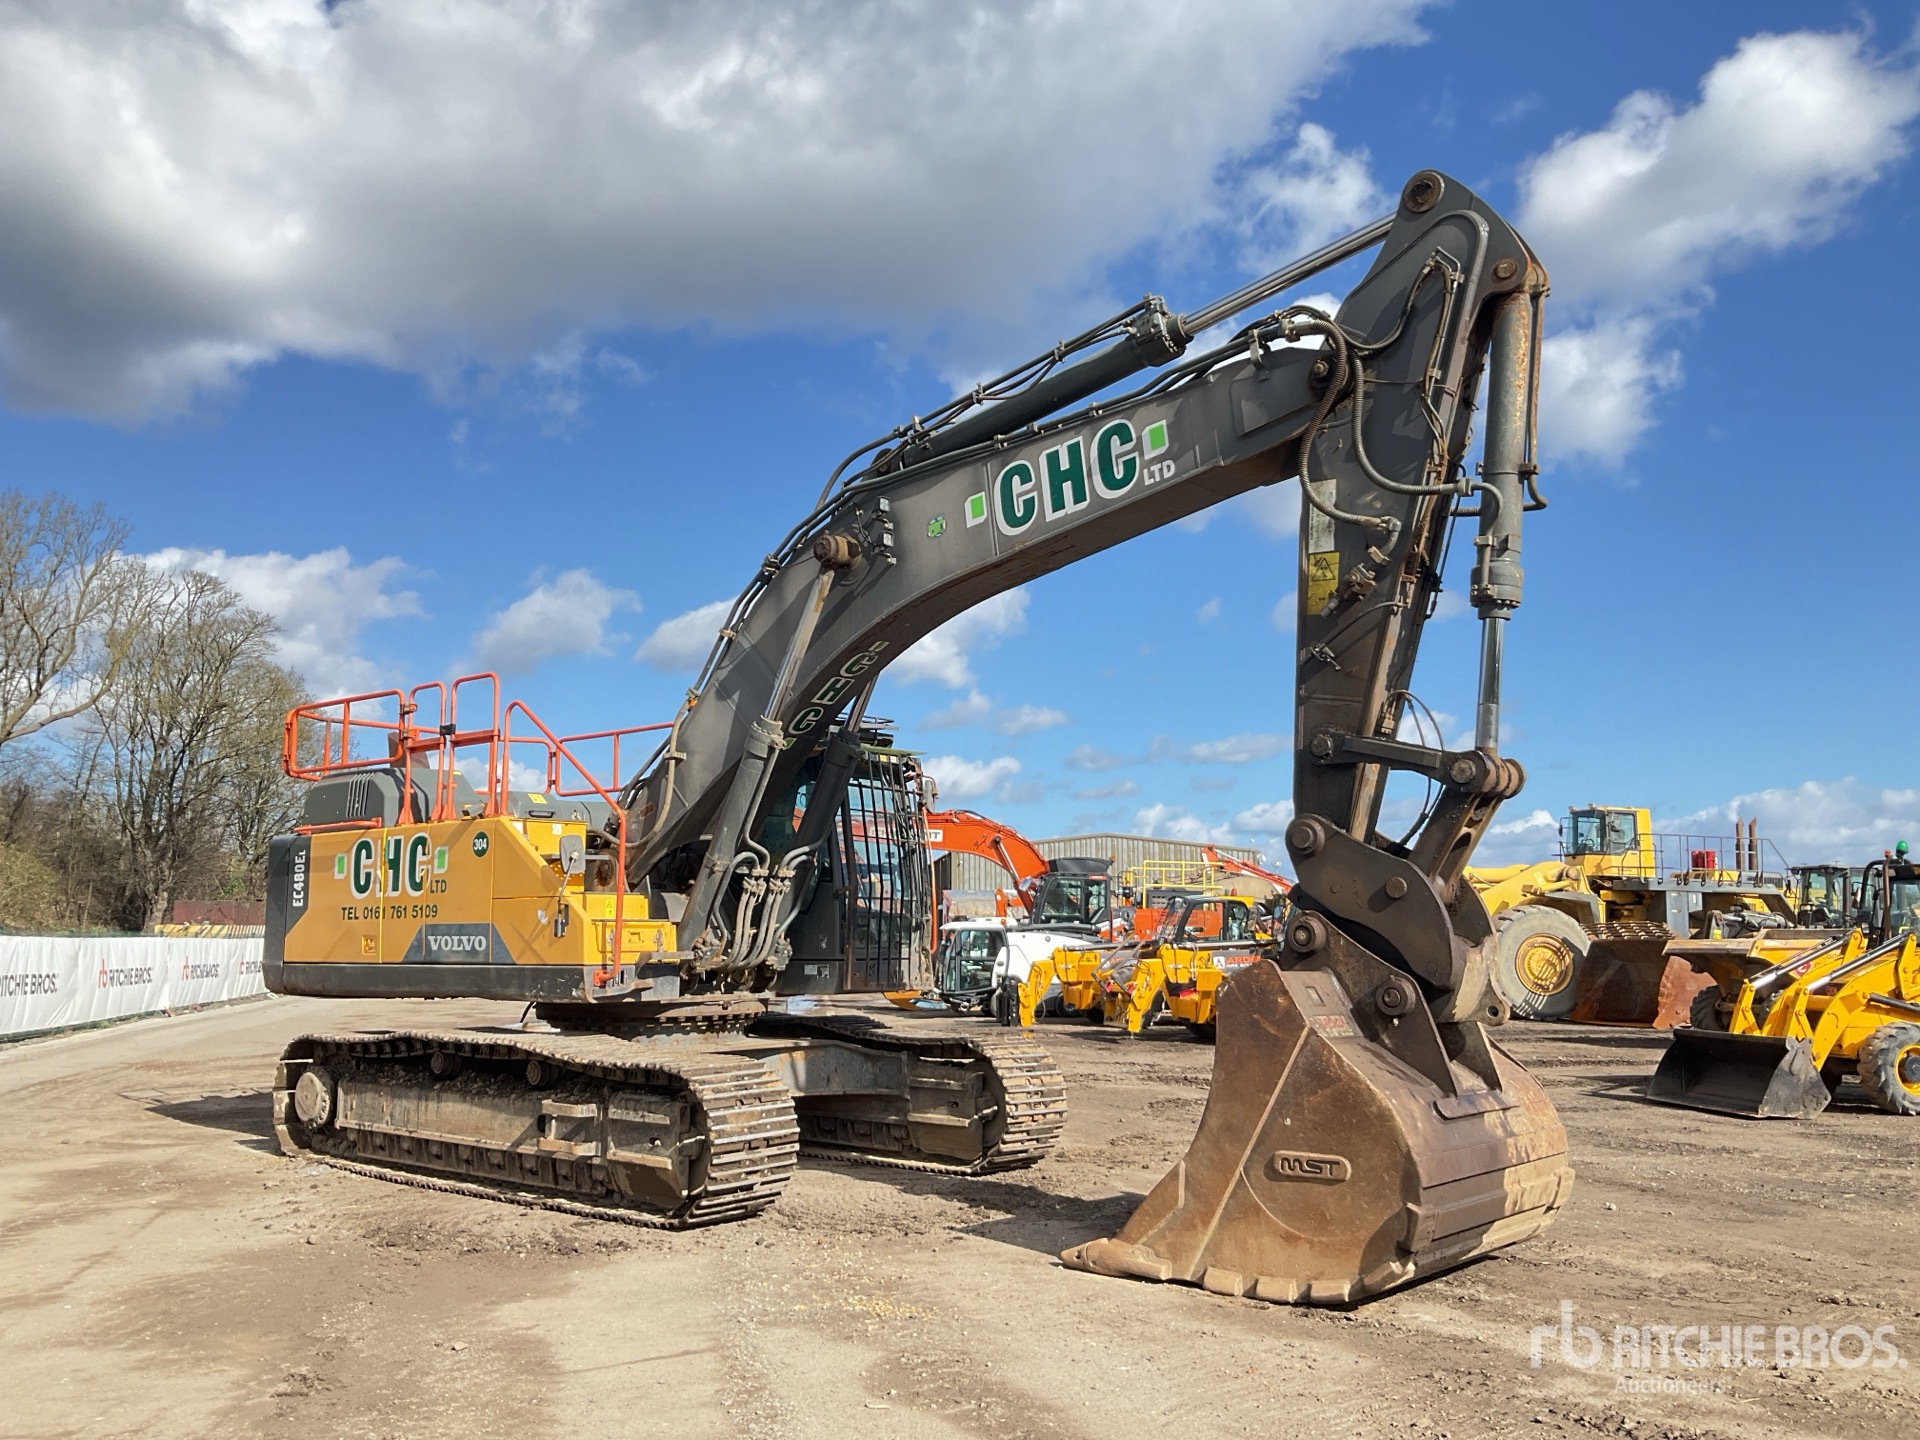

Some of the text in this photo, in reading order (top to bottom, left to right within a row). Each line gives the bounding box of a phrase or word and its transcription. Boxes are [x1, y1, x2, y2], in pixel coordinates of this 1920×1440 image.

[994, 419, 1175, 536] CHC LTD
[788, 651, 878, 735] CHC
[473, 837, 488, 851] 304
[350, 831, 447, 899] CHC LTD
[341, 906, 360, 921] TEL
[390, 905, 407, 919] 761
[411, 904, 438, 919] 5109
[427, 935, 487, 951] VOLVO
[0, 973, 30, 997] ITCHIE
[1280, 1157, 1341, 1176] MST
